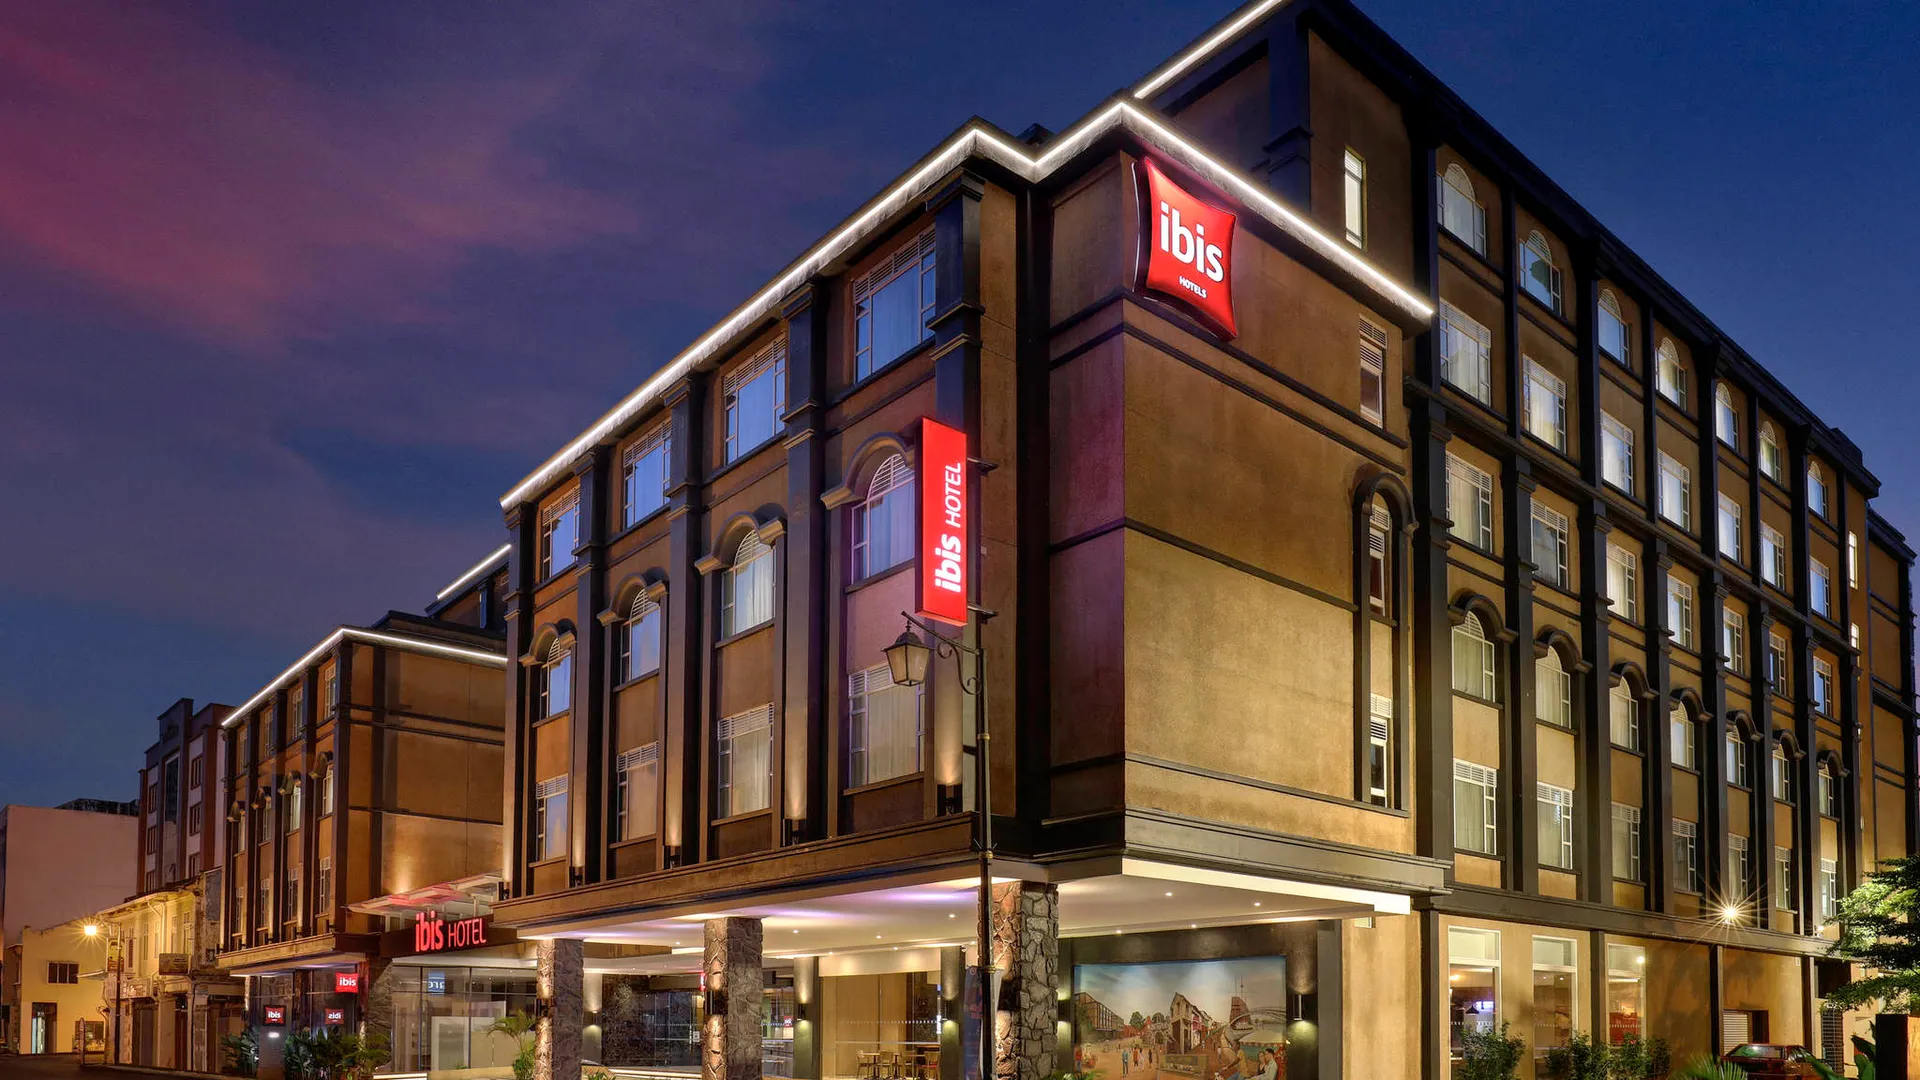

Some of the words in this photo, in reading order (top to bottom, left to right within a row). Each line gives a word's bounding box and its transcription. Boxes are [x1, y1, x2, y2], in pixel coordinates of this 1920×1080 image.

[1160, 201, 1224, 282] ibis
[1179, 276, 1207, 298] HOTELS
[945, 462, 961, 527] HOTEL
[935, 534, 961, 592] ibis
[415, 910, 444, 952] ibis
[448, 917, 487, 948] HOTEL
[339, 977, 357, 987] ibis
[267, 1010, 281, 1018] ibis
